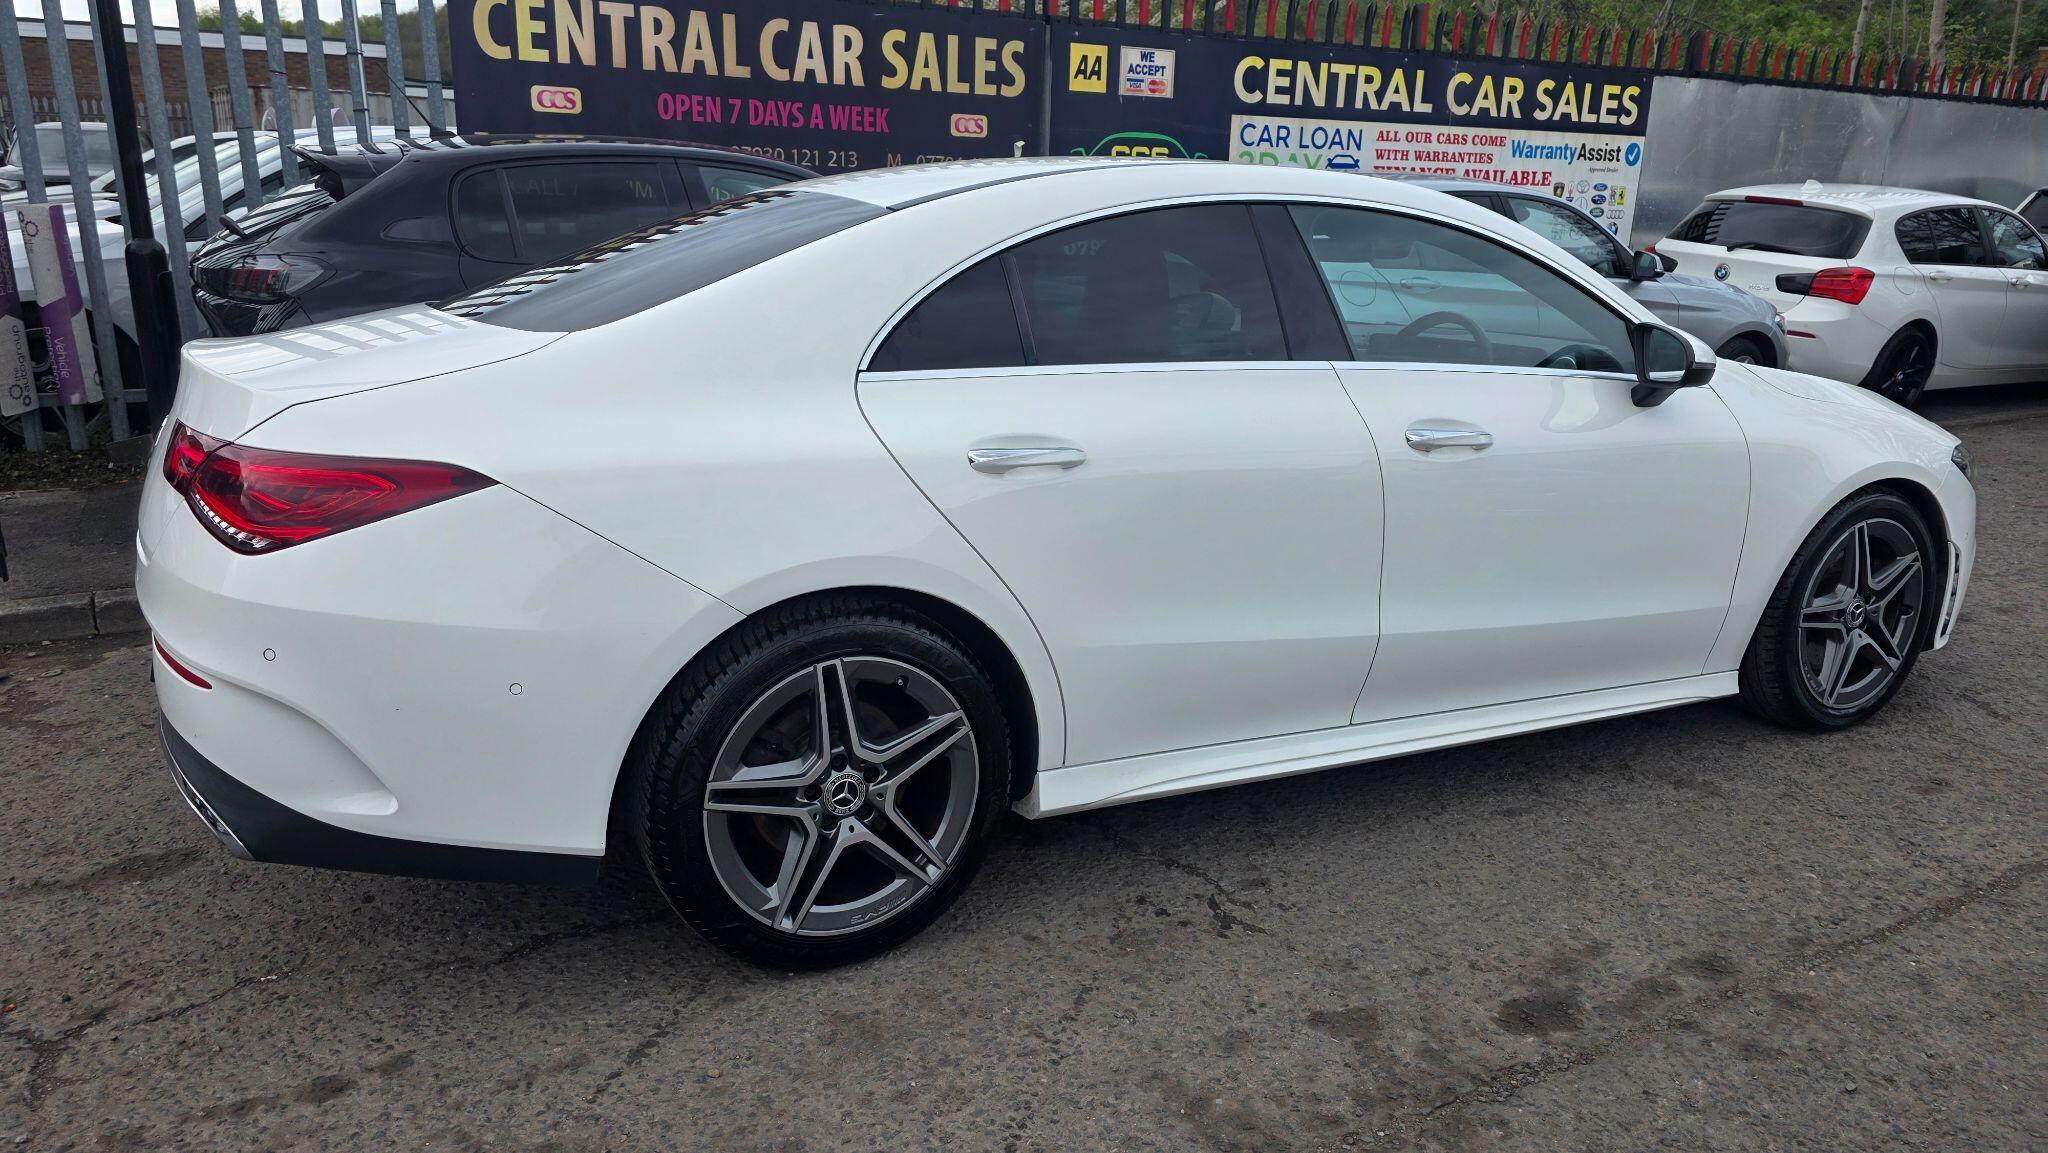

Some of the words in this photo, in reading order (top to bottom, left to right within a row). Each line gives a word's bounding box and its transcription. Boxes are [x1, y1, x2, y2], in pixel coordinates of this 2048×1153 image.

[473, 0, 751, 78] CENTRAL
[760, 18, 865, 87] CAR
[881, 29, 1026, 97] SALES
[1140, 50, 1155, 63] WE
[1074, 54, 1102, 80] AA
[1127, 63, 1166, 77] ACCEPT
[1234, 55, 1433, 113] CENTRAL
[1446, 72, 1525, 119] CAR
[1533, 78, 1641, 126] SALES
[657, 92, 721, 123] OPEN
[728, 98, 742, 124] 7
[749, 98, 803, 128] DAYS
[809, 103, 824, 130] A
[828, 104, 890, 133] WEEK
[1239, 123, 1291, 148] CAR
[1300, 126, 1363, 151] LOAN
[1376, 130, 1400, 142] ALL
[1405, 131, 1432, 144] OUR
[1436, 133, 1468, 146] CARS
[1472, 134, 1507, 147] COME
[791, 149, 819, 166] 121
[827, 150, 858, 168] 213
[1375, 149, 1410, 161] WITH
[1414, 150, 1494, 164] WARRANTIES
[1463, 169, 1553, 186] AVAILABLE
[54, 336, 72, 378] Vehicle
